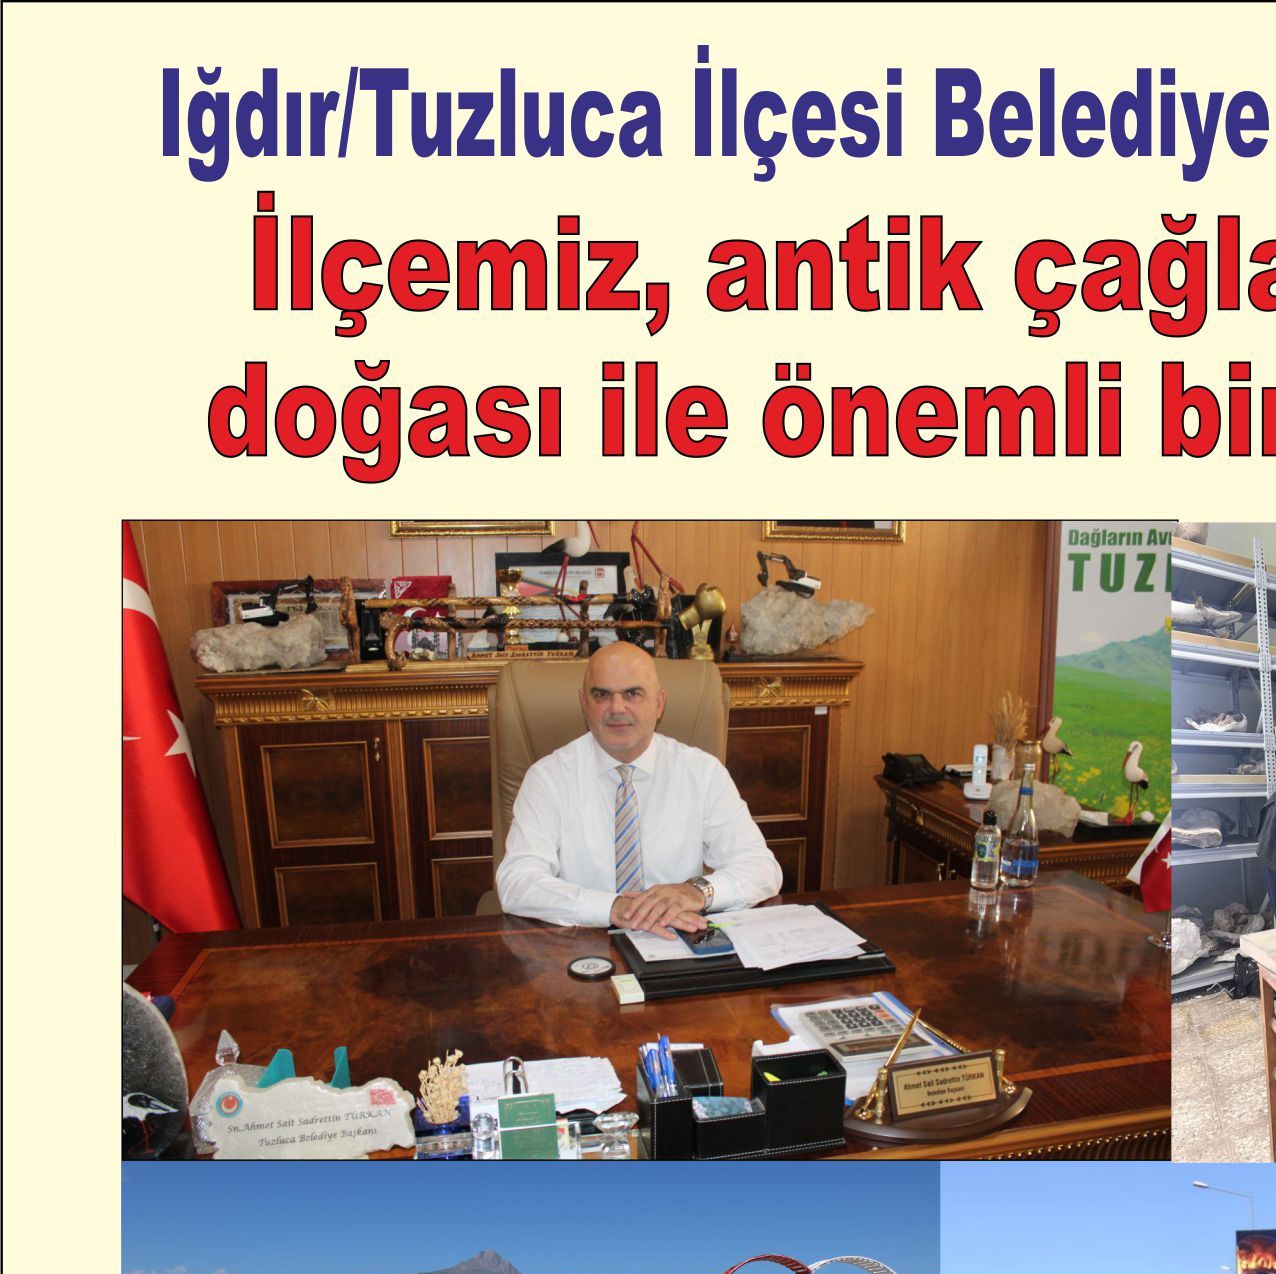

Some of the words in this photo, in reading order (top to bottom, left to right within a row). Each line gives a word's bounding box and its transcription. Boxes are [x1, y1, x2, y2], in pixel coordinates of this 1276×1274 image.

[1068, 528, 1143, 548] Dağların
[276, 1118, 295, 1128] Sait
[298, 1114, 341, 1127] Sadrettin
[258, 1135, 296, 1148] Tuzluca
[299, 1131, 337, 1144] Belediye
[341, 1127, 378, 1140] Başkanı
